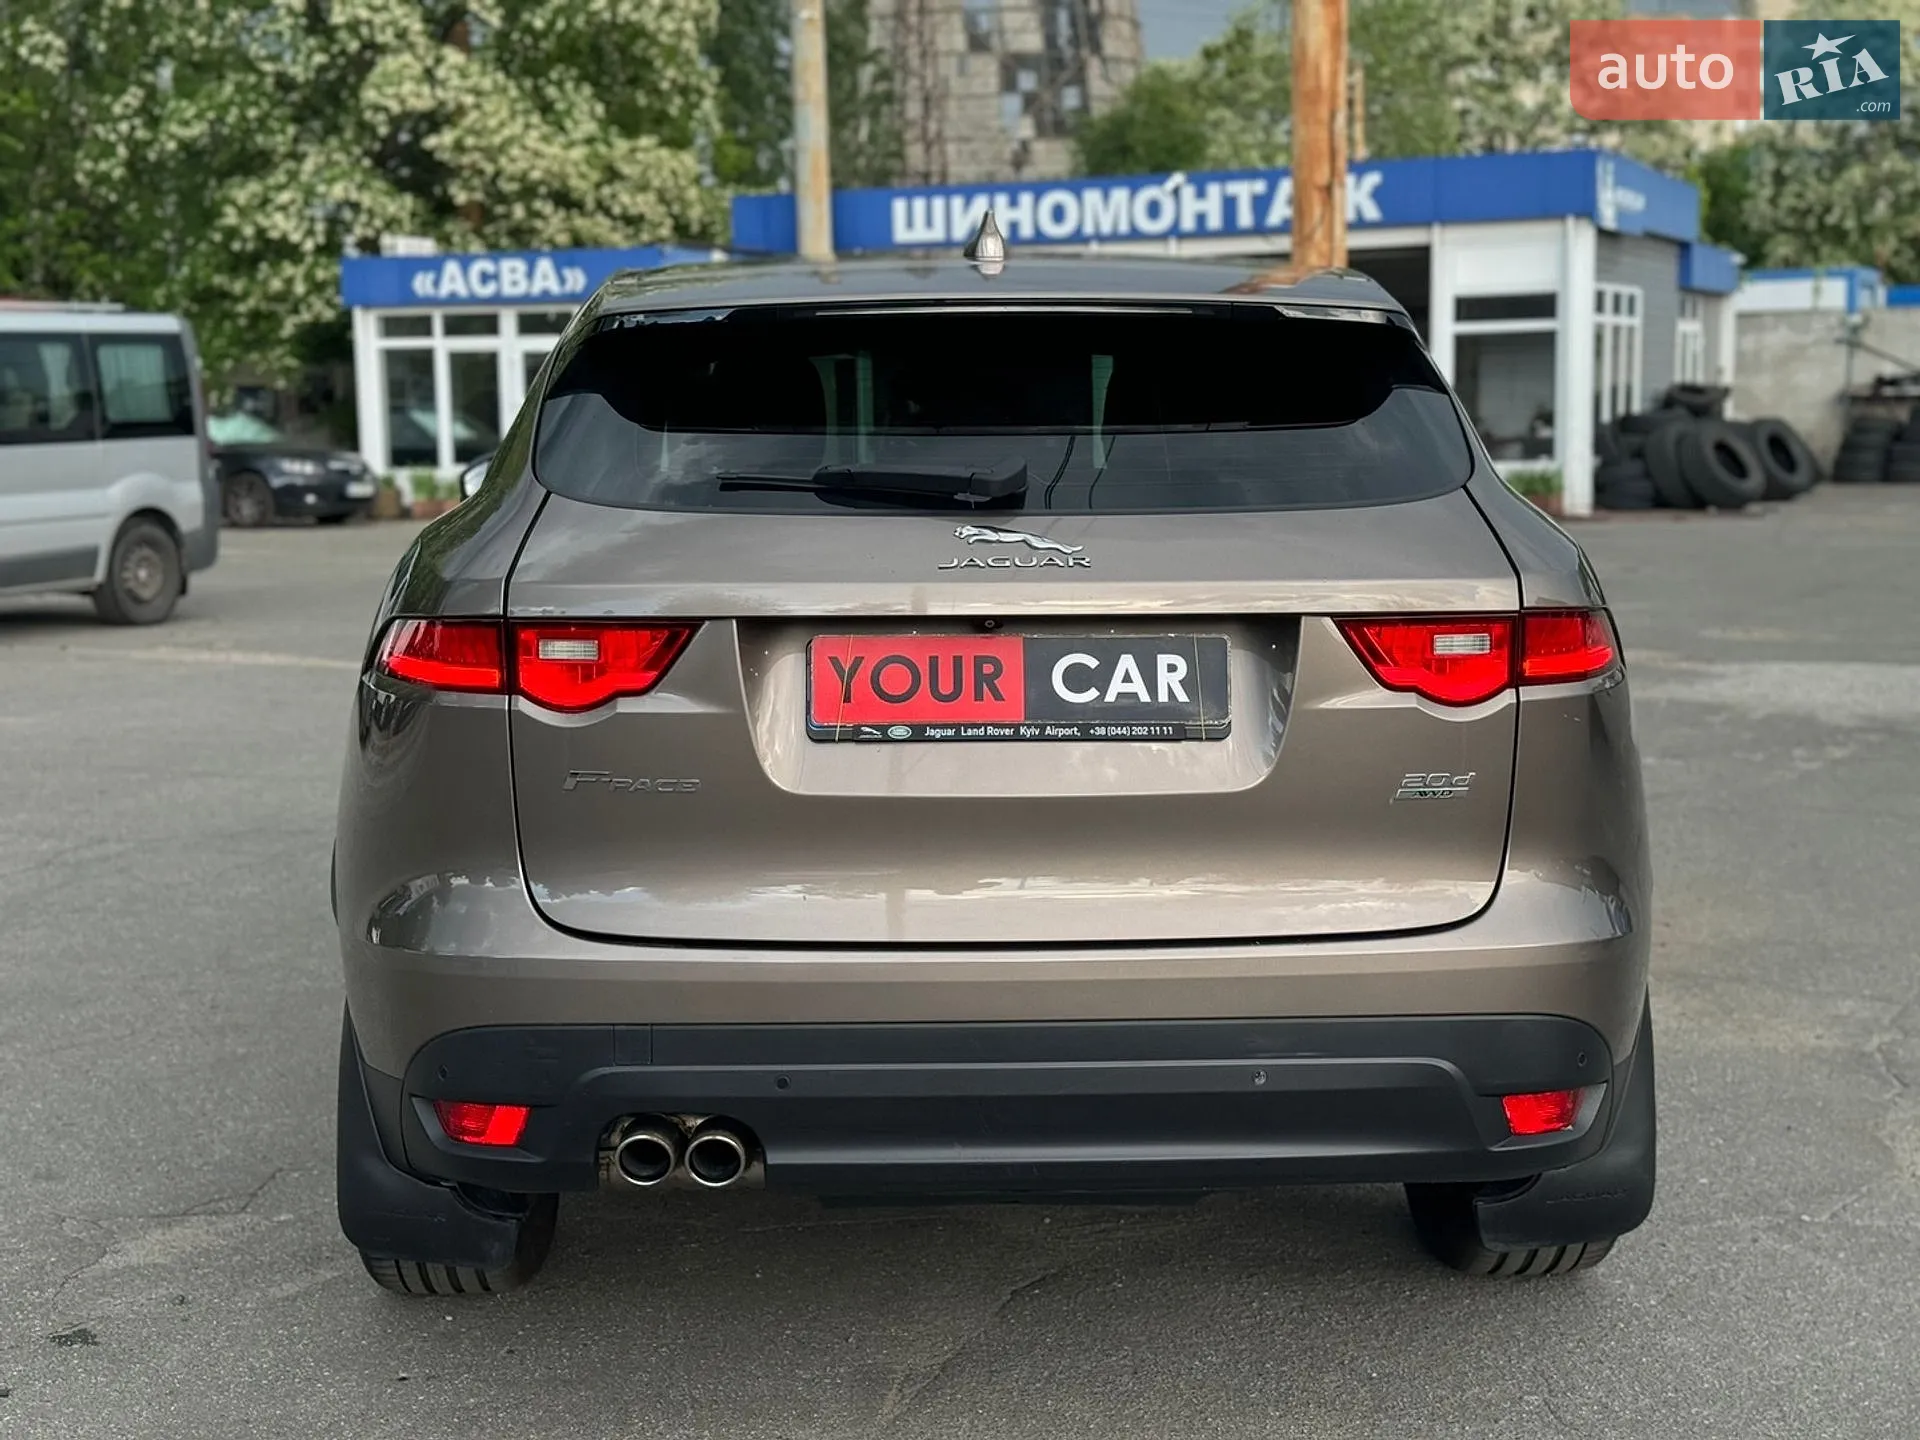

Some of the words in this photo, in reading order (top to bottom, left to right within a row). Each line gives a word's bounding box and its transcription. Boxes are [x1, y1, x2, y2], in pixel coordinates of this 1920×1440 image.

[937, 556, 1091, 570] JAGUAR
[828, 655, 1006, 704] YOUR
[1051, 653, 1191, 703] CAR
[924, 726, 956, 738] Jaguar
[961, 726, 985, 736] Land
[986, 726, 1014, 736] Rover
[1019, 725, 1040, 738] Kyiv
[1045, 726, 1081, 738] Airport,
[1401, 772, 1476, 787] 20d
[1412, 790, 1454, 799] AWD
